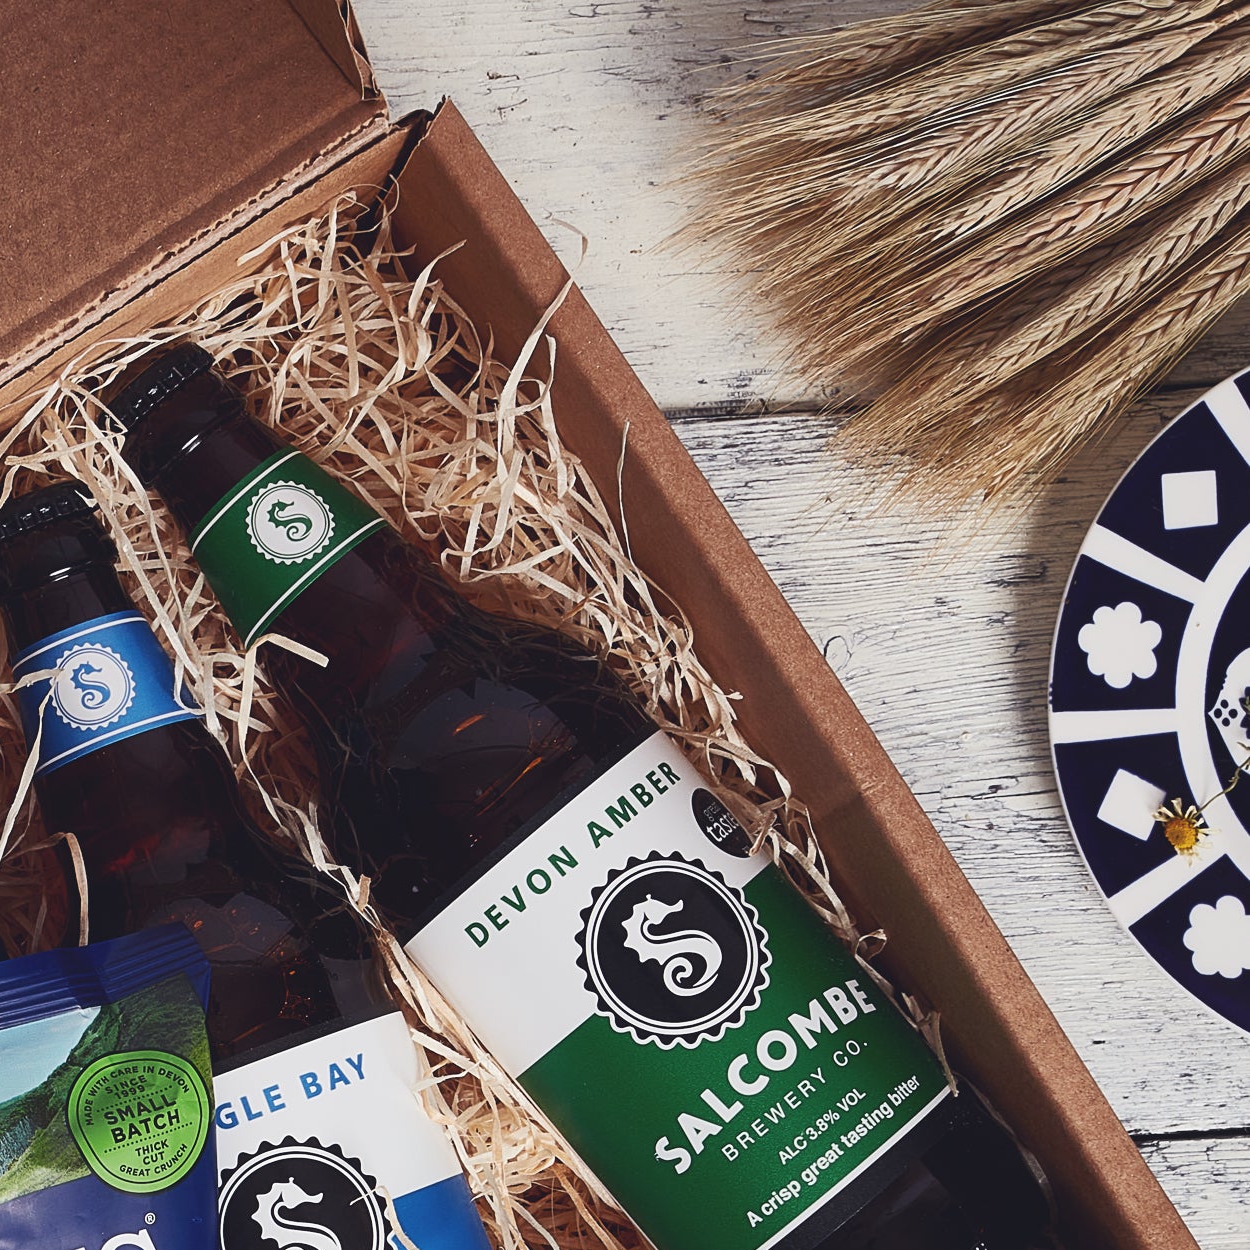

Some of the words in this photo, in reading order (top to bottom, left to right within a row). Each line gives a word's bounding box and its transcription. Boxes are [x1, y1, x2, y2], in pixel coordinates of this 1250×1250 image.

[464, 845, 579, 948] DEVON
[587, 761, 681, 849] AMBER
[110, 1066, 139, 1079] CARE
[143, 1066, 155, 1074] IN
[158, 1067, 190, 1094] DEVON
[299, 1053, 365, 1100] BAY
[654, 979, 877, 1175] SALCOMBE
[88, 1076, 110, 1097] WITH
[105, 1075, 148, 1095] SINCE
[114, 1084, 146, 1100] 1999
[84, 1099, 95, 1126] MADE
[103, 1094, 178, 1125] SMALL
[721, 1067, 827, 1162] BREWERY
[832, 1039, 868, 1068] CO.
[110, 1108, 181, 1144] BATCH
[777, 1134, 808, 1165] ALC
[806, 1109, 841, 1141] 3.8%
[836, 1087, 867, 1112] VOL
[119, 1164, 151, 1177] GREAT
[154, 1143, 188, 1175] CRUNCH
[134, 1138, 169, 1157] THICK
[142, 1151, 165, 1166] CUT
[745, 1210, 764, 1228] A
[760, 1180, 803, 1217] crisp
[801, 1143, 845, 1187] great
[840, 1101, 895, 1148] tasting
[887, 1074, 921, 1109] bitter
